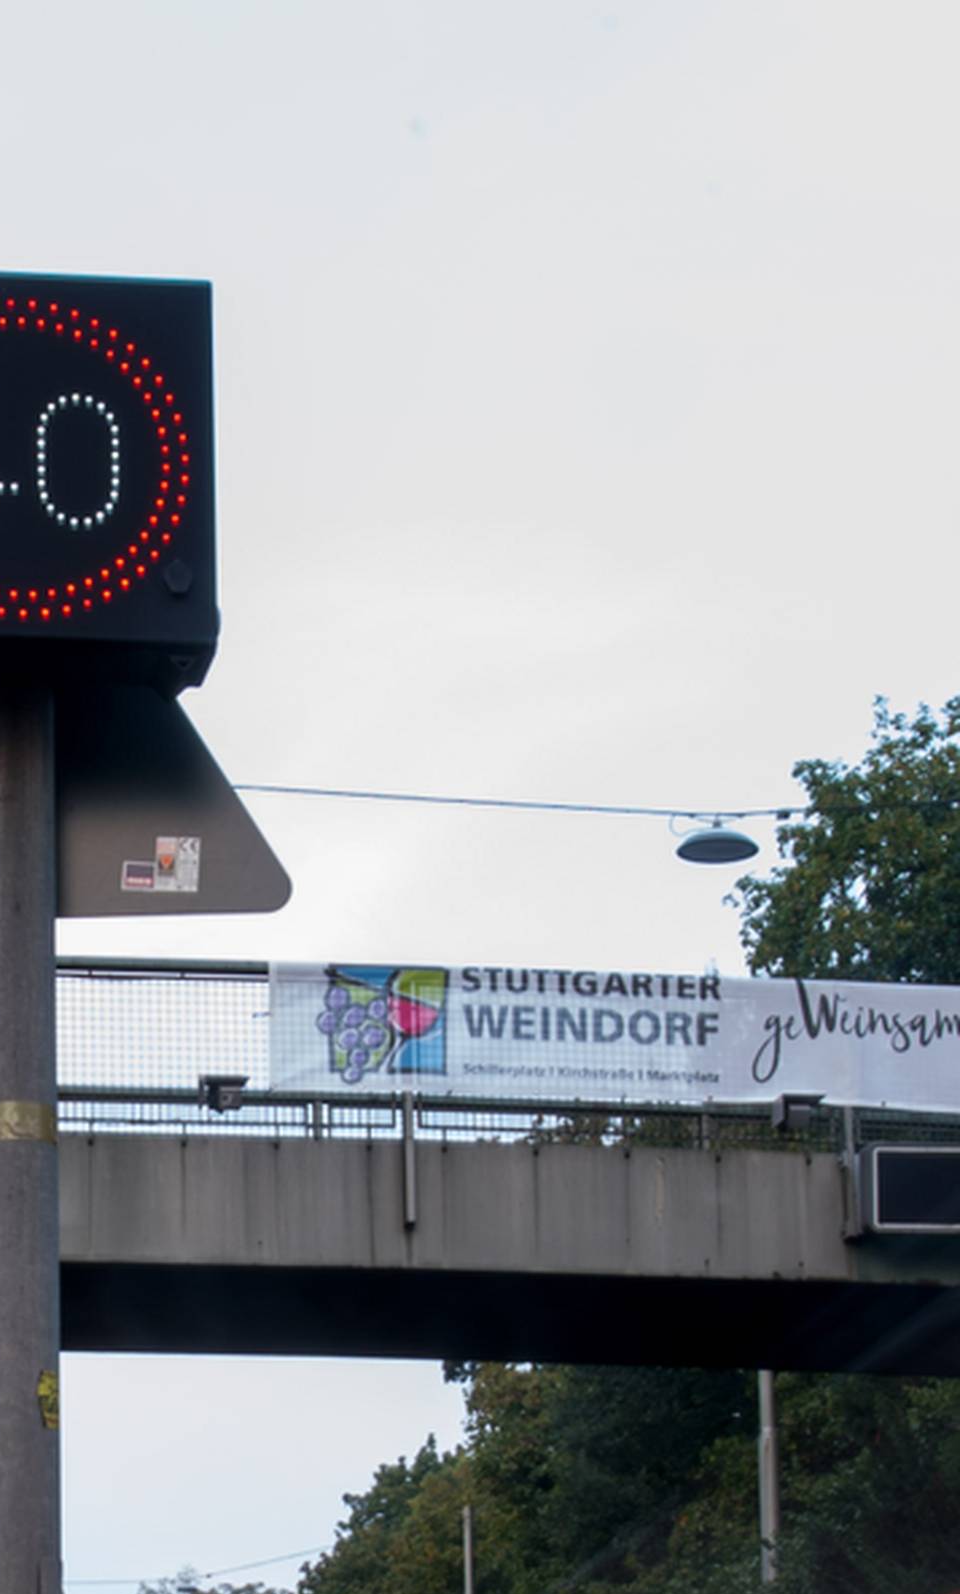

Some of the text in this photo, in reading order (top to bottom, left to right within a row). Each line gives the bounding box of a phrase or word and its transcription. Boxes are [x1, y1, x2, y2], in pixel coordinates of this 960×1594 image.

[461, 967, 721, 1001] STUTTGARTER
[463, 1004, 720, 1046] WEINDORF
[646, 1069, 720, 1084] Marktplatz
